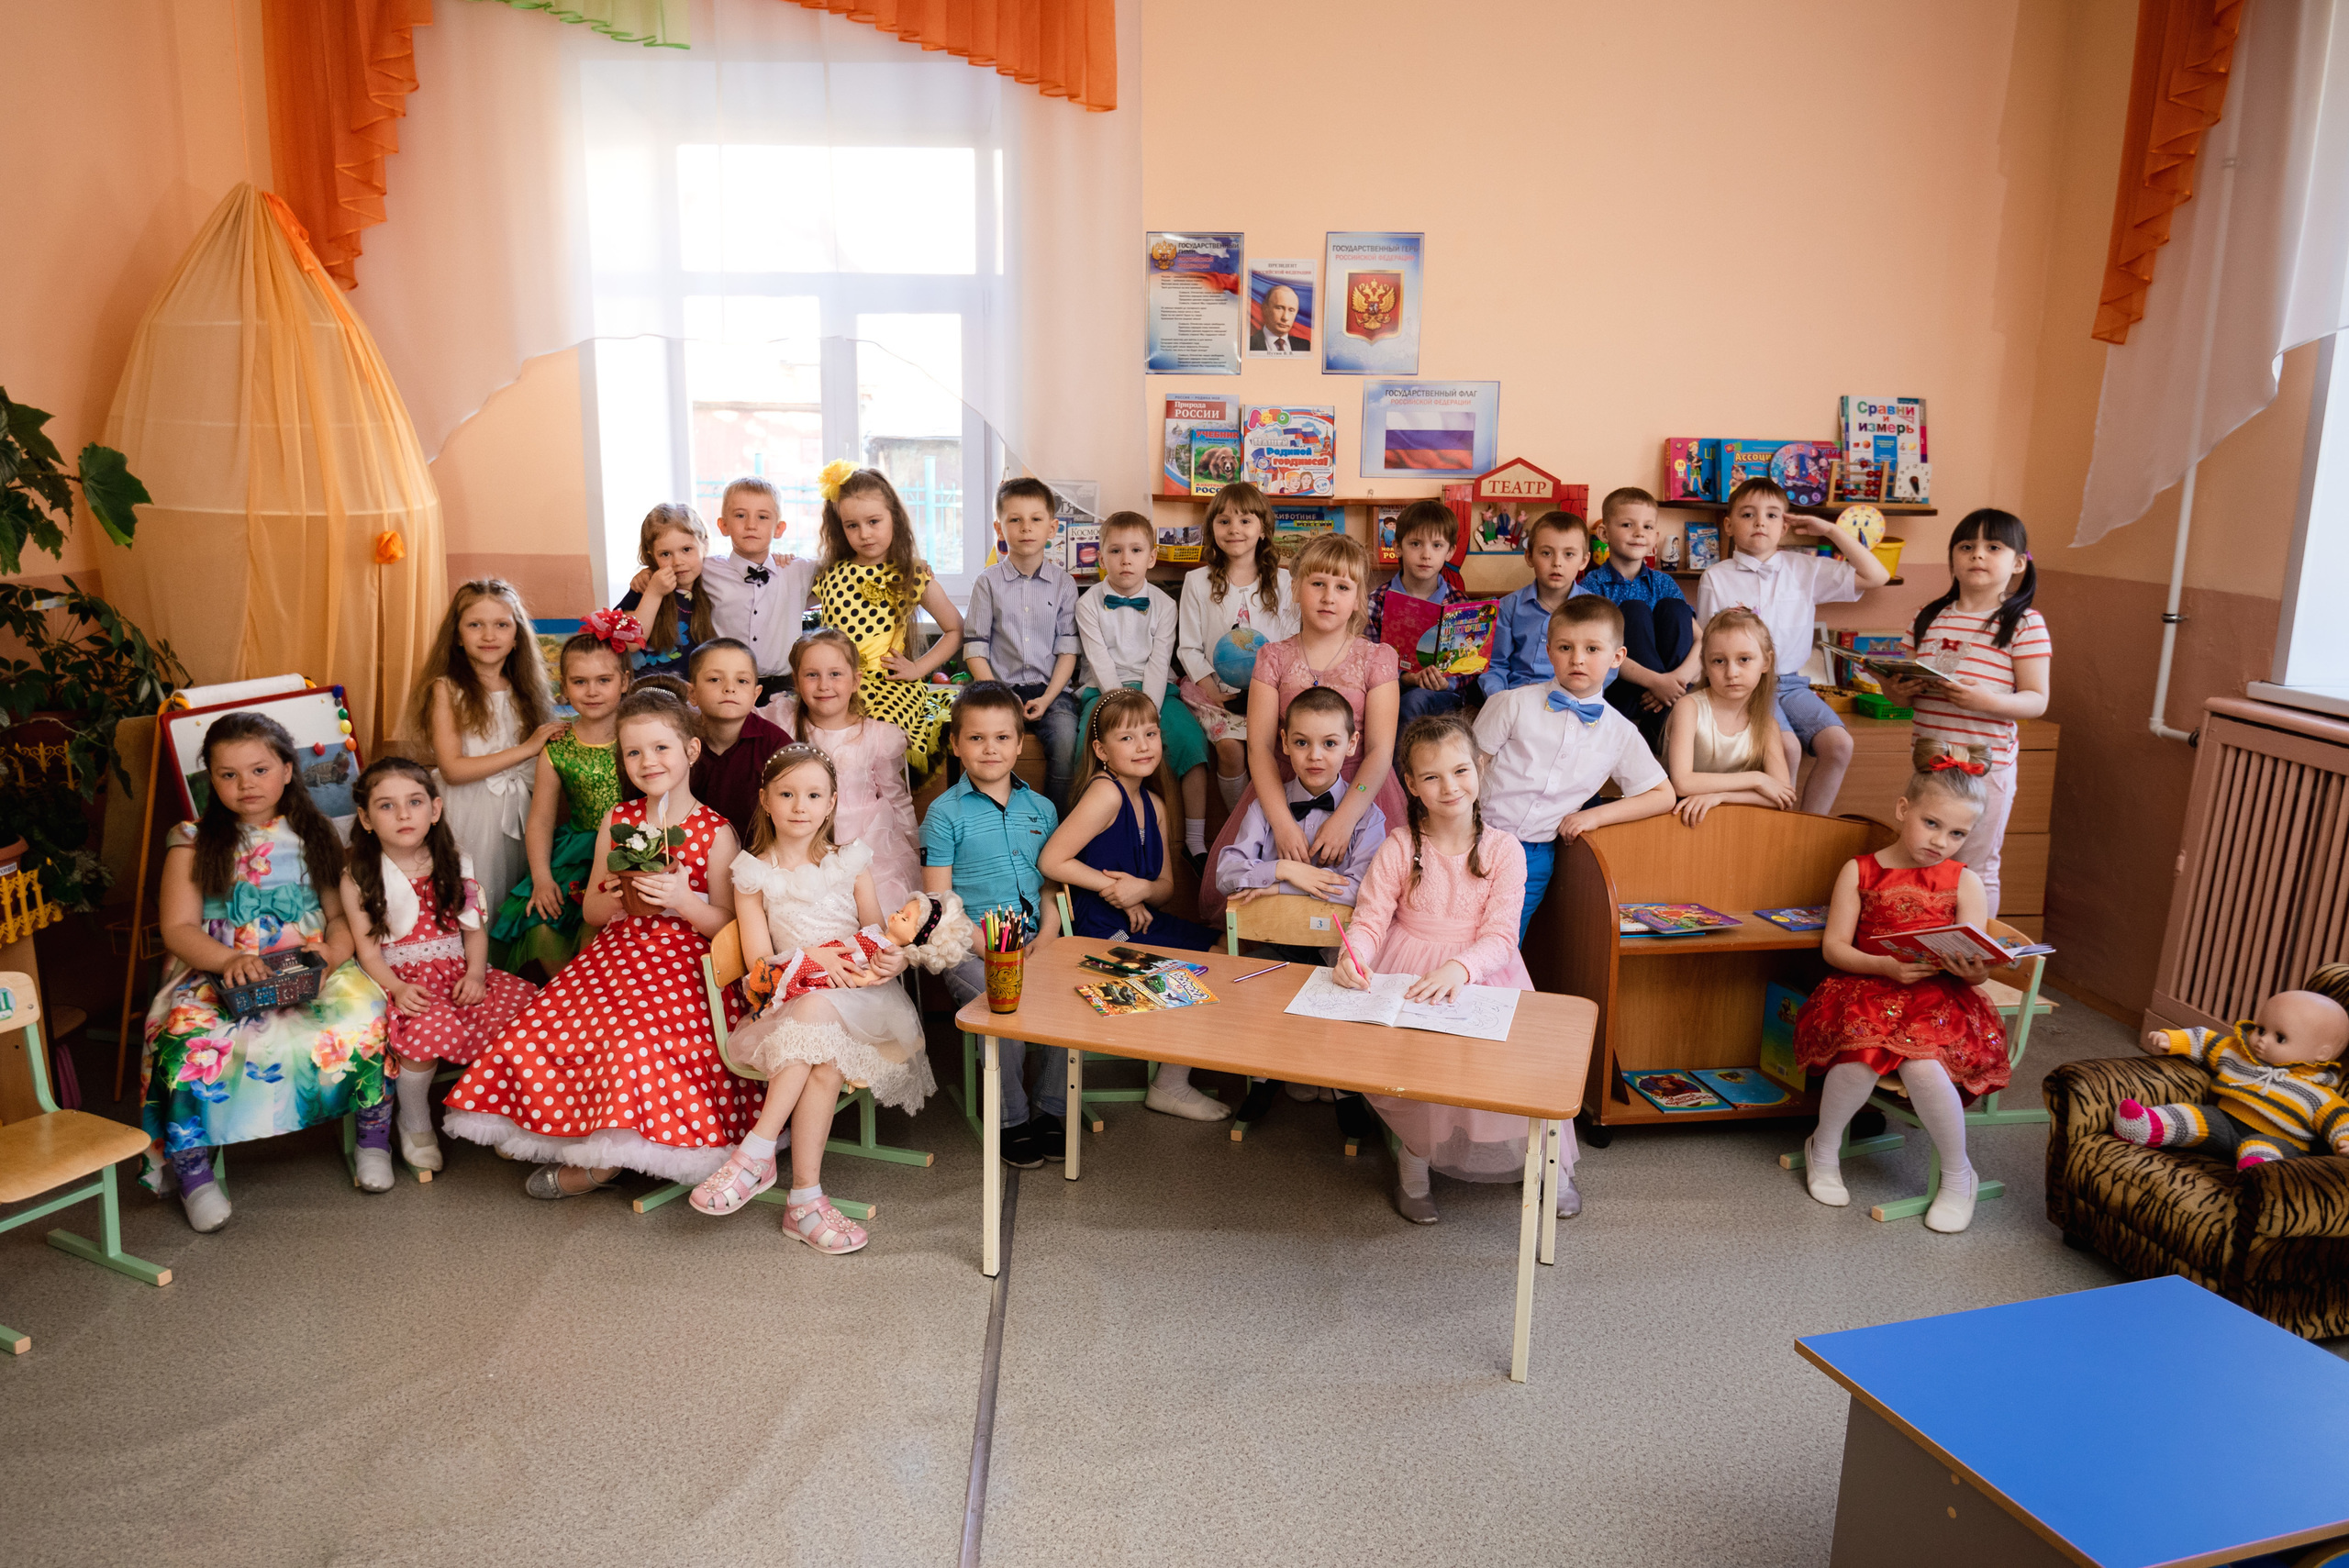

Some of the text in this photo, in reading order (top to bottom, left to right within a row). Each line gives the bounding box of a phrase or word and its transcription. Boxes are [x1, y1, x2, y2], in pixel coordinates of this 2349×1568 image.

[1332, 244, 1399, 252] ГОСУДАРСТВЕННЫЙ
[1385, 389, 1457, 397] ГОСУДАРСТВЕННЫЙ
[1174, 409, 1219, 418] РОССИИ
[1857, 401, 1915, 417] Сравни
[1858, 422, 1915, 436] измерь
[1196, 430, 1240, 439] УЧЕБНИК
[1266, 447, 1312, 457] Родиной
[1735, 452, 1772, 462] Ассоци
[1488, 480, 1546, 495] ТЕАТР
[1071, 528, 1099, 537] КОСМО
[1317, 920, 1322, 929] 3
